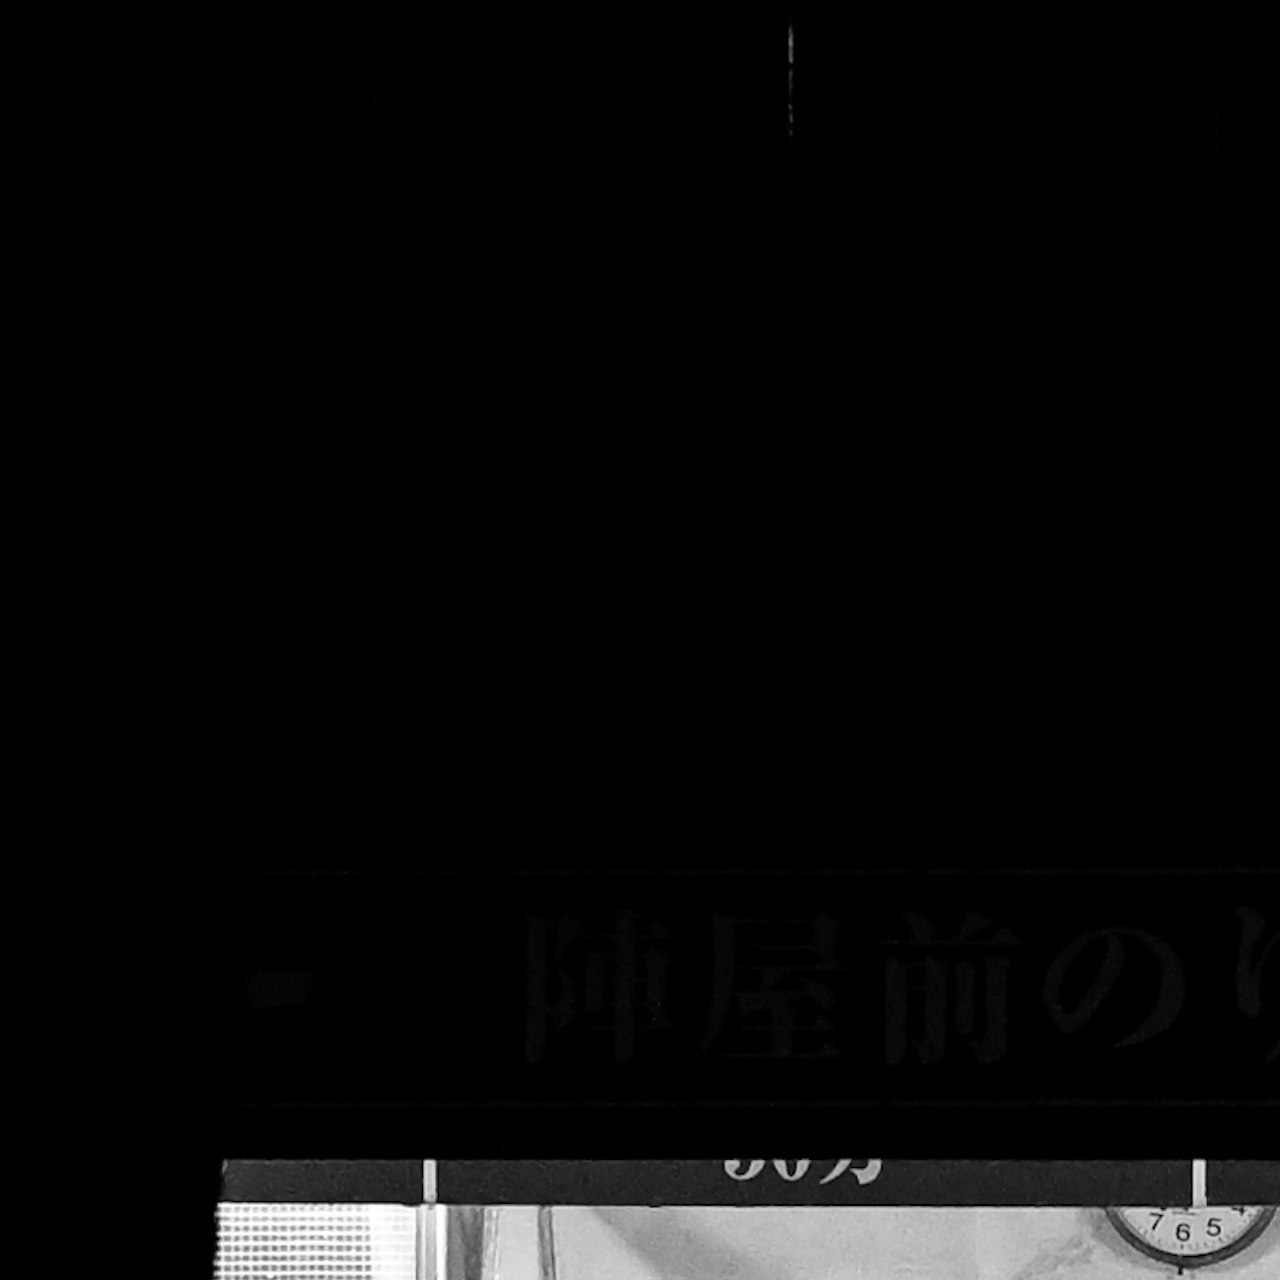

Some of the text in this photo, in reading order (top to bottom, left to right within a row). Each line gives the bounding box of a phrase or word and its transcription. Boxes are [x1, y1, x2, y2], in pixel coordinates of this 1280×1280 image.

[1149, 1212, 1164, 1230] 7
[1206, 1218, 1222, 1237] 5
[1176, 1223, 1190, 1241] 6
